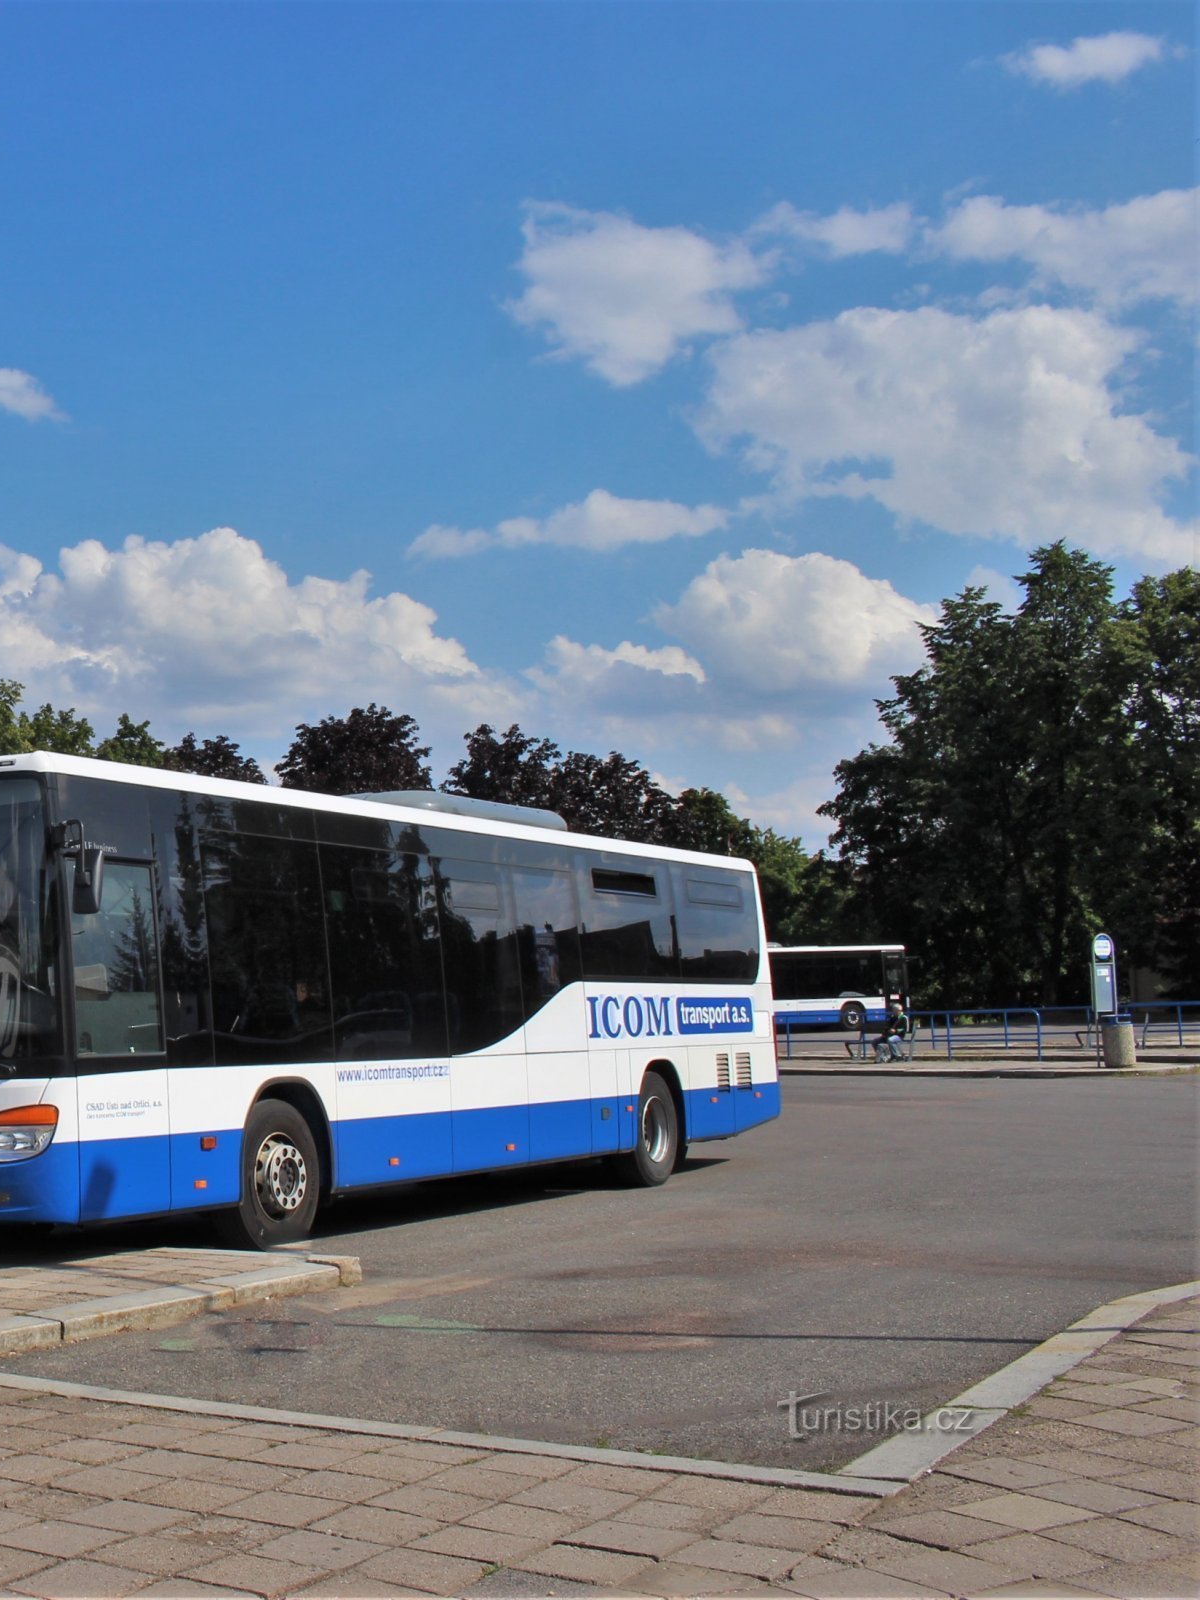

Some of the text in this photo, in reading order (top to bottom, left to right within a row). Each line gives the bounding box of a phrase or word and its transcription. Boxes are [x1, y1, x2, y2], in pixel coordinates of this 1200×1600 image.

[587, 996, 750, 1038] ICOM transport a.s.
